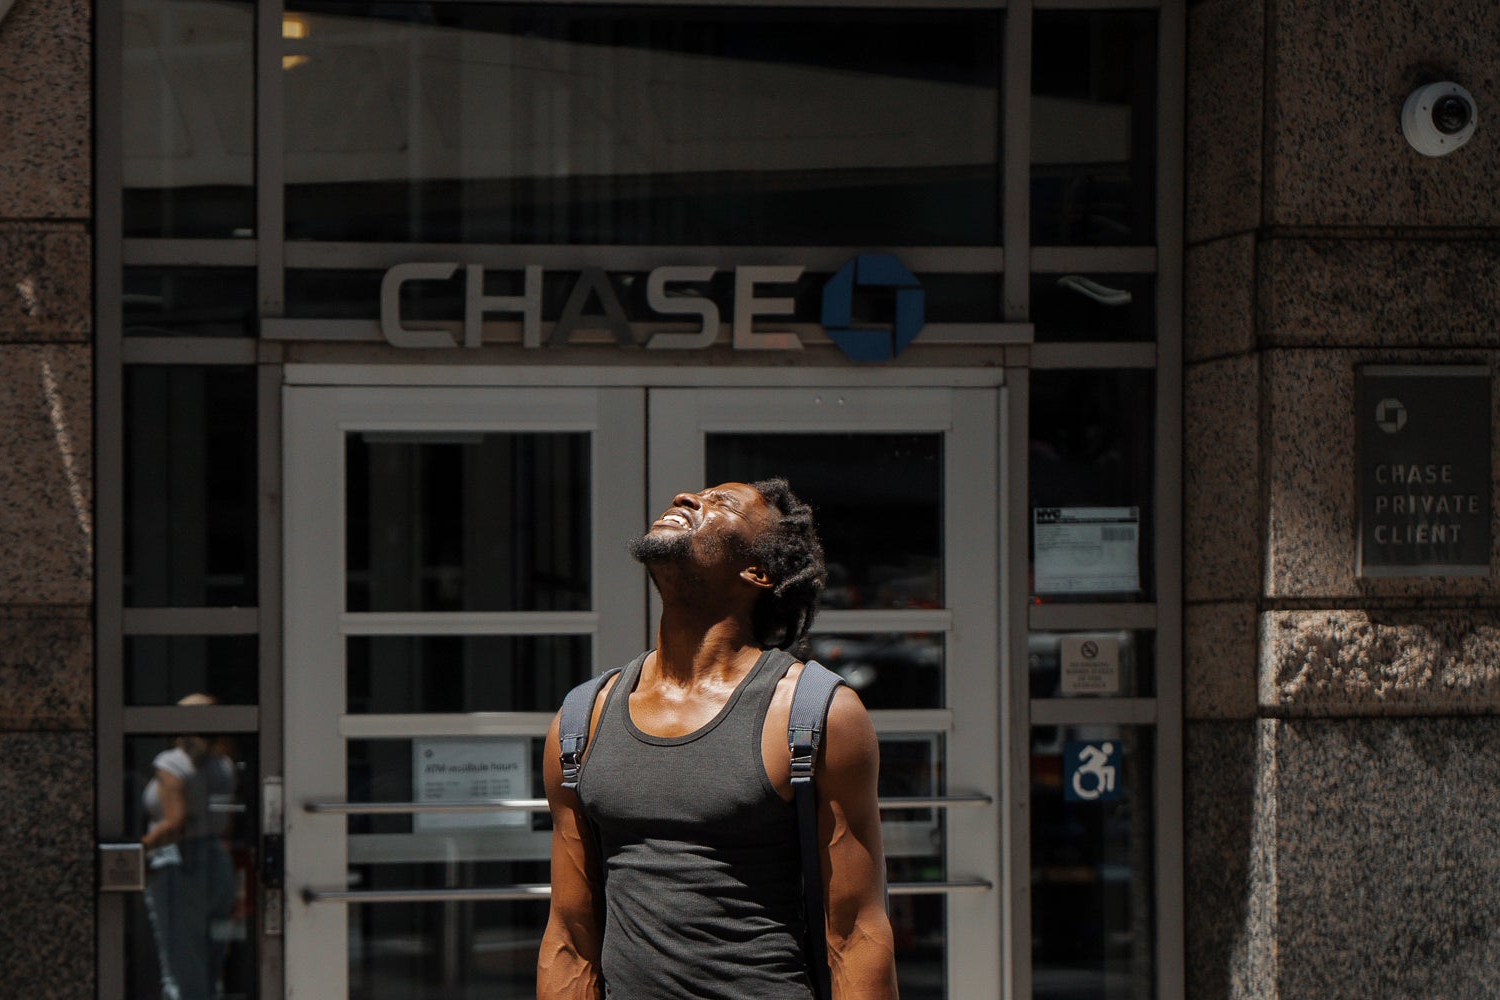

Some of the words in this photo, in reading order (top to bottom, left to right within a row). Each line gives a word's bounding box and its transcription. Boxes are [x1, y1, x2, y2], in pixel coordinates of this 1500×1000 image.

[380, 262, 806, 350] CHASE
[1375, 464, 1452, 483] CHASE
[1376, 495, 1480, 514] PRIVATE
[1374, 524, 1461, 544] CLIENT
